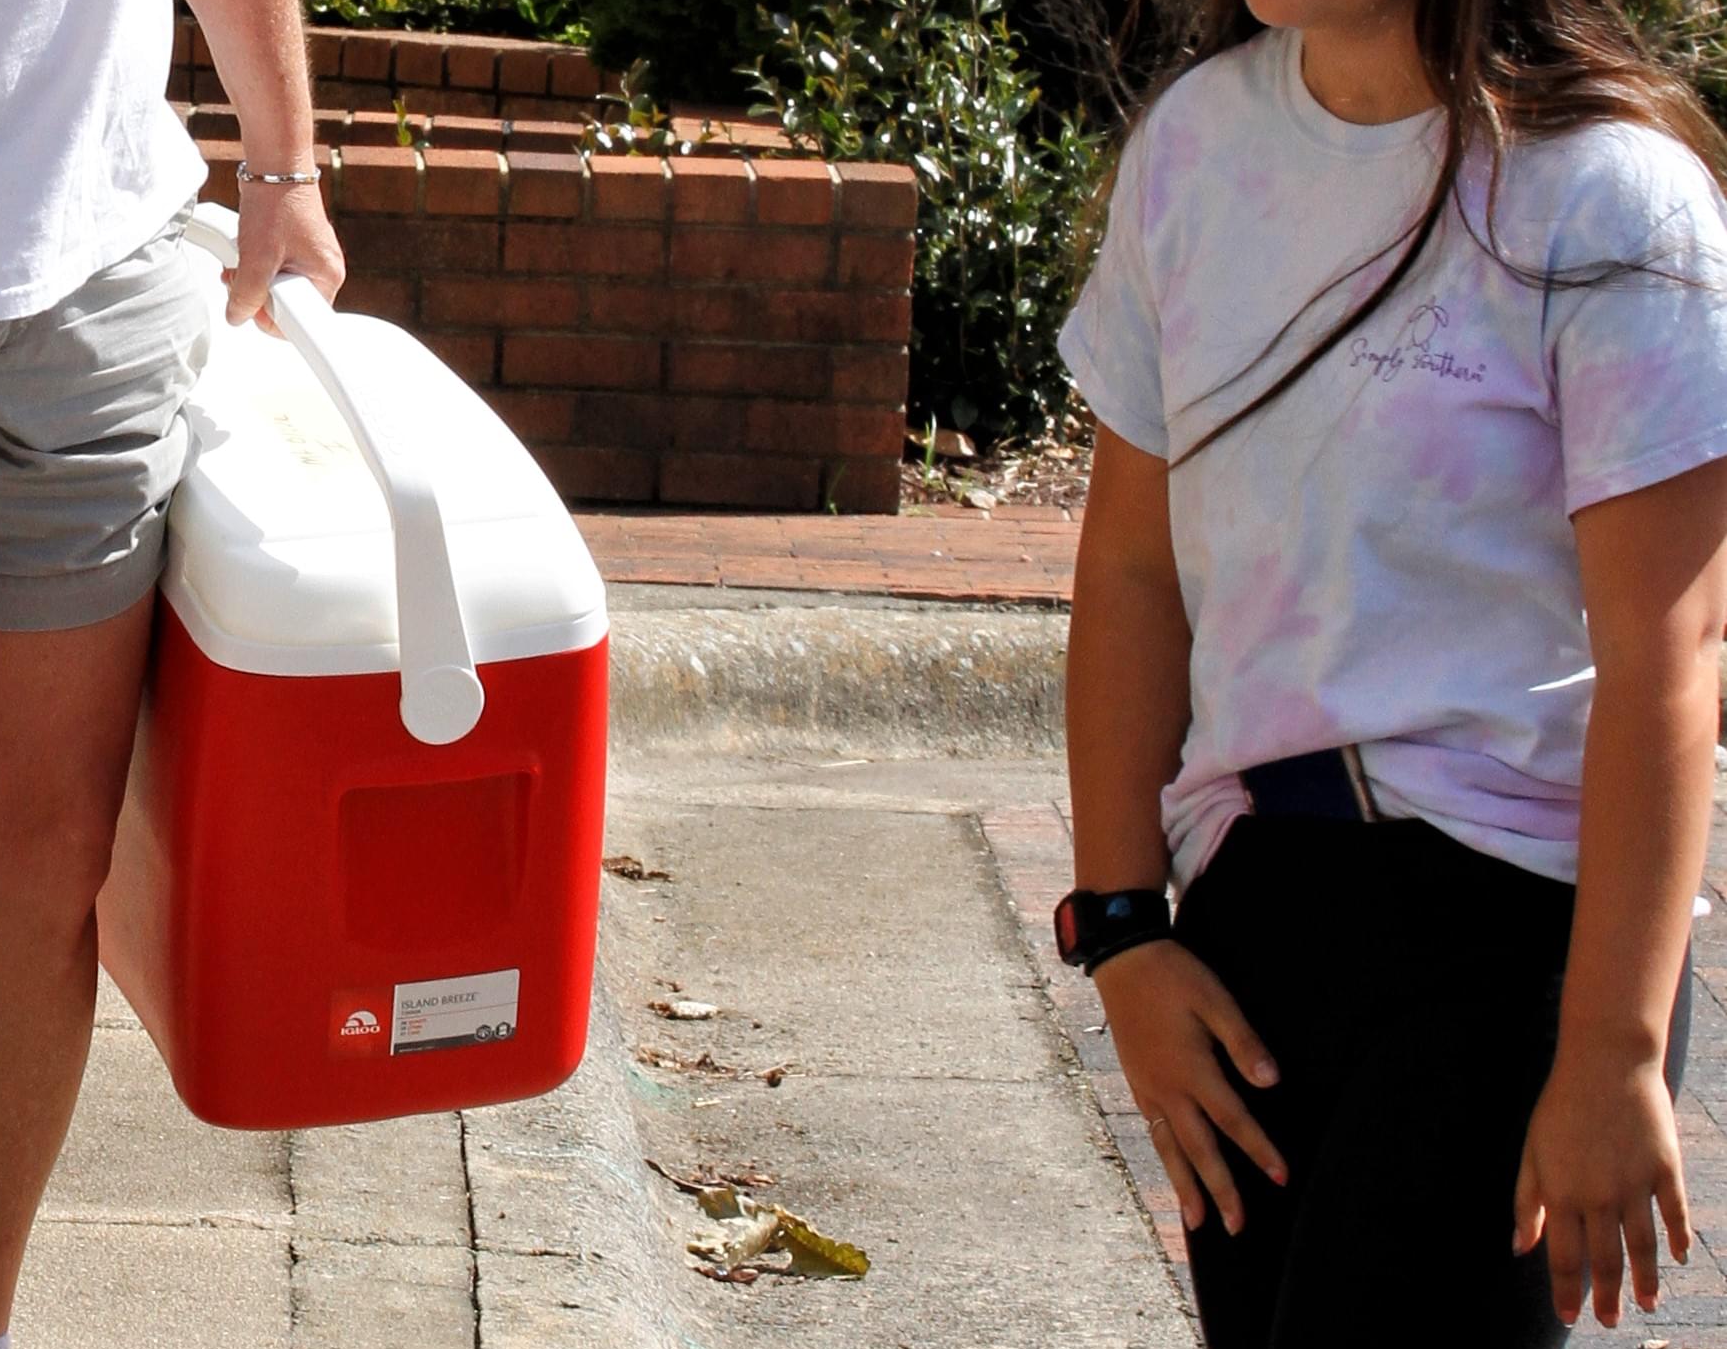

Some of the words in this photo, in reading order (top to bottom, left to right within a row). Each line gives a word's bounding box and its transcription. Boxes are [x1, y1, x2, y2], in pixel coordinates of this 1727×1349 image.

[1349, 337, 1405, 383] Simply
[401, 996, 439, 1010] ISLAND
[441, 992, 477, 1005] BREEZE
[340, 1025, 381, 1036] IGLOO
